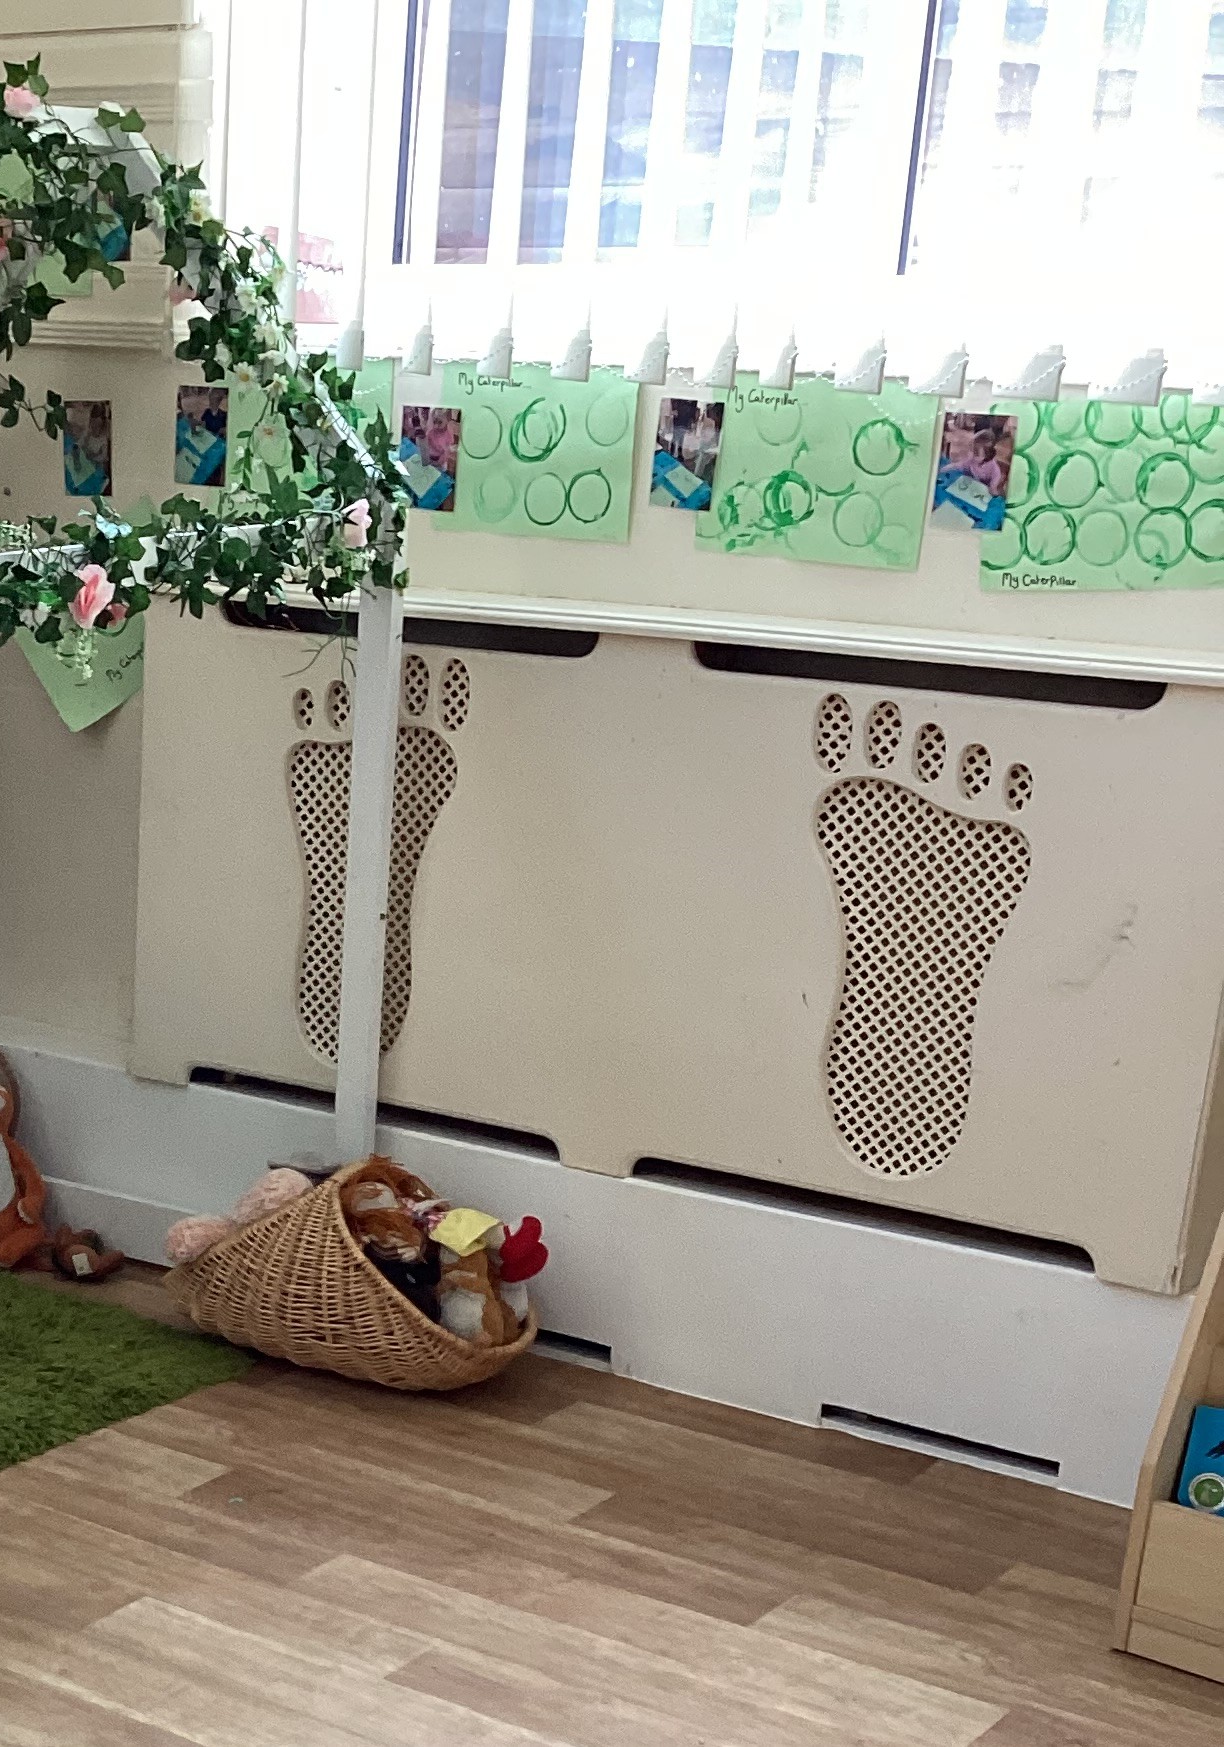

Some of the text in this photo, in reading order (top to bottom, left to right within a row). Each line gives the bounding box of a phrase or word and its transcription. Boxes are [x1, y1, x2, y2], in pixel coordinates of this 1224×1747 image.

[458, 372, 474, 395] My
[727, 385, 798, 413] My Caterpillar
[1002, 572, 1019, 589] My
